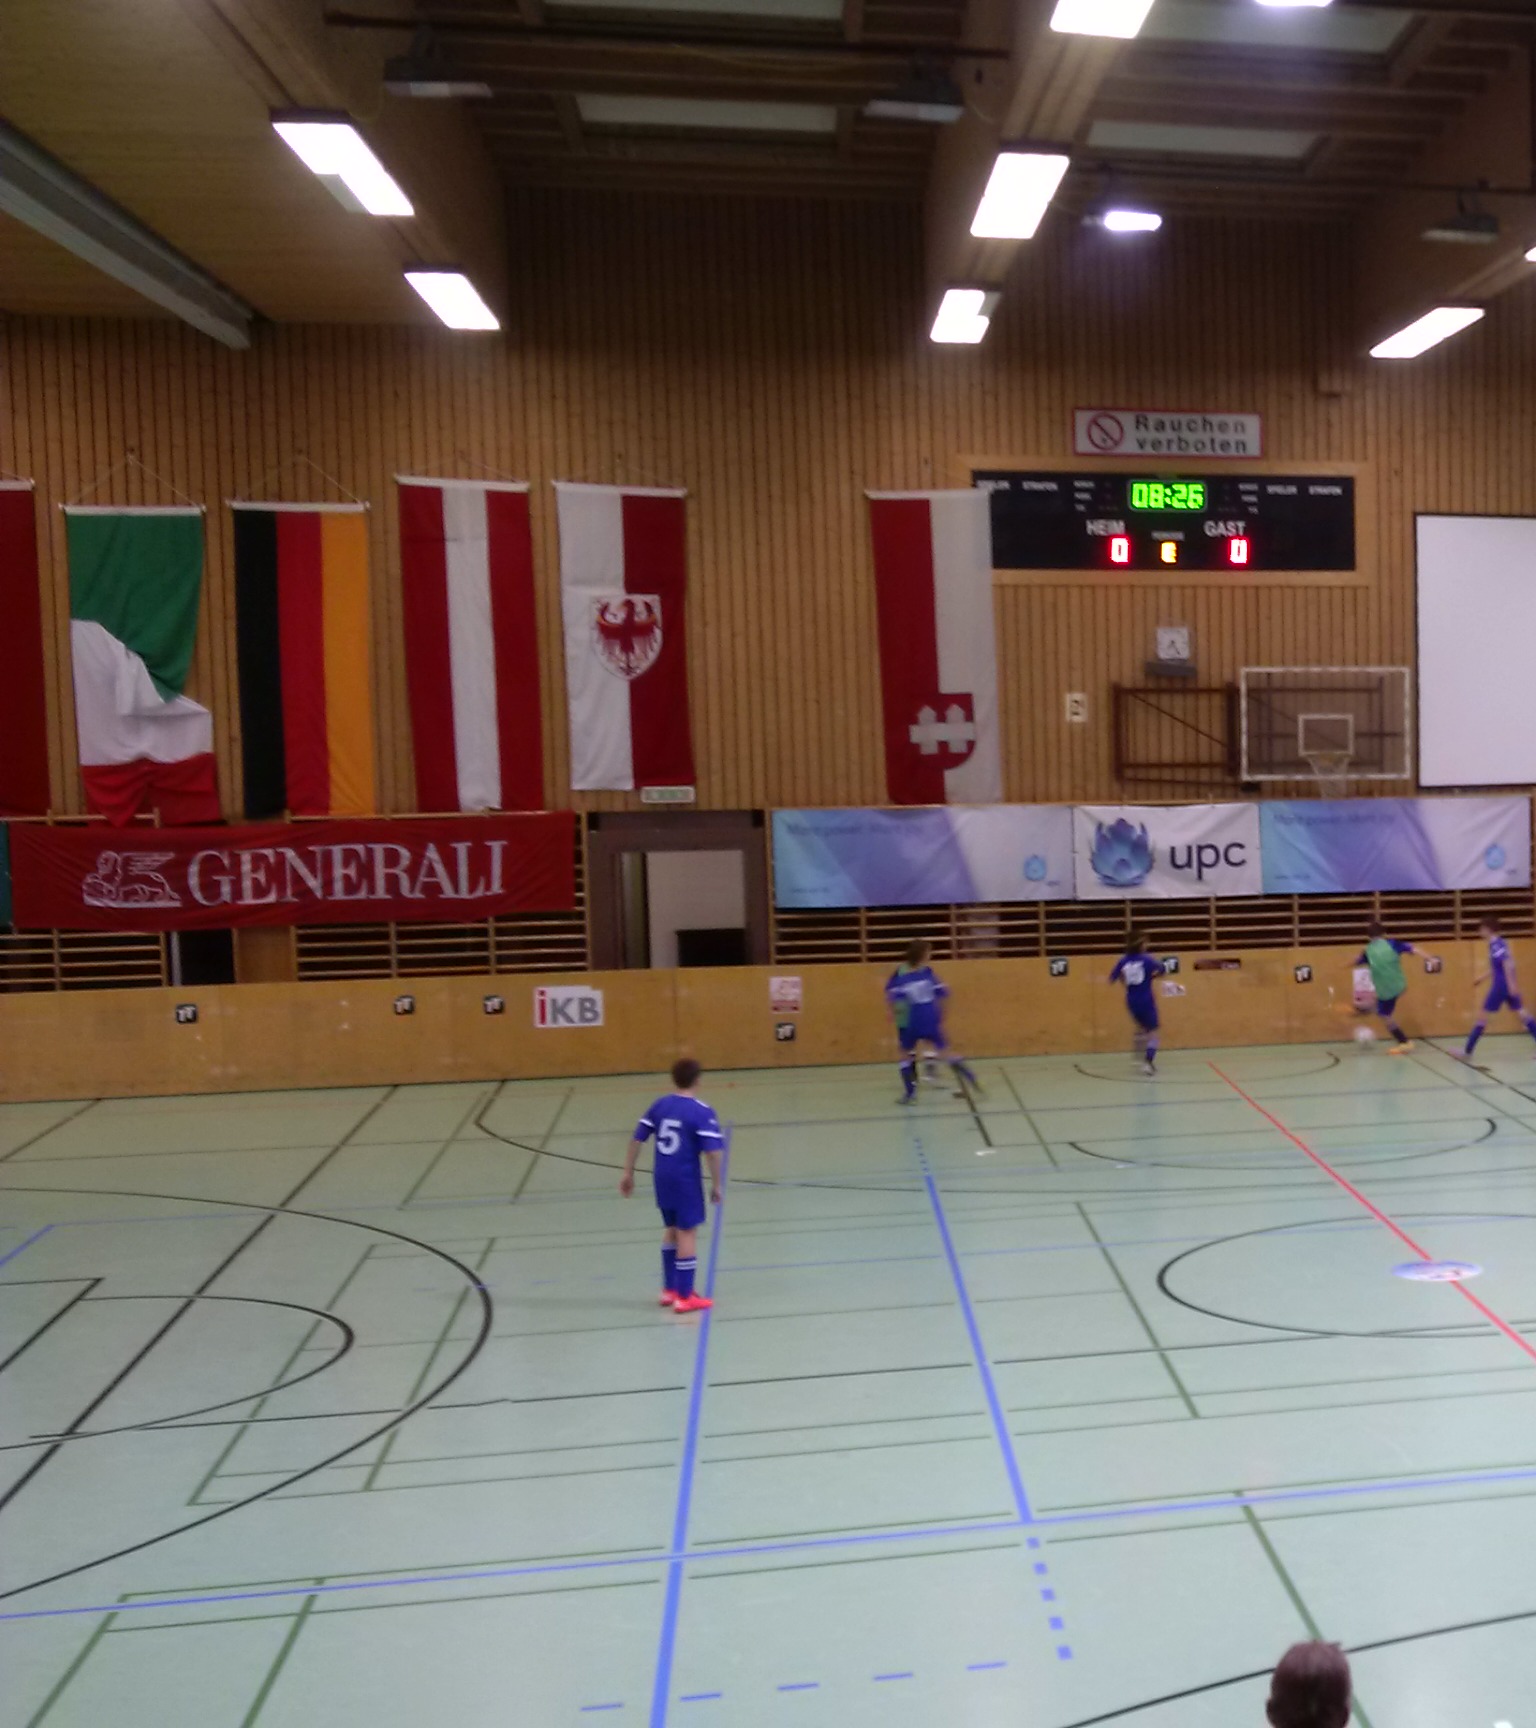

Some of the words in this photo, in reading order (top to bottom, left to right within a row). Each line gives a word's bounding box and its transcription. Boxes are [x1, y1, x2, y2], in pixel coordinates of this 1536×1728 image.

[1135, 413, 1246, 433] Rauchen
[1135, 434, 1247, 453] verboten
[1132, 482, 1204, 509] 08:26
[1086, 518, 1125, 537] HEIM
[1204, 519, 1246, 538] GAST
[1170, 840, 1248, 881] upc
[187, 840, 508, 906] GENERALI
[656, 1119, 682, 1155] 5
